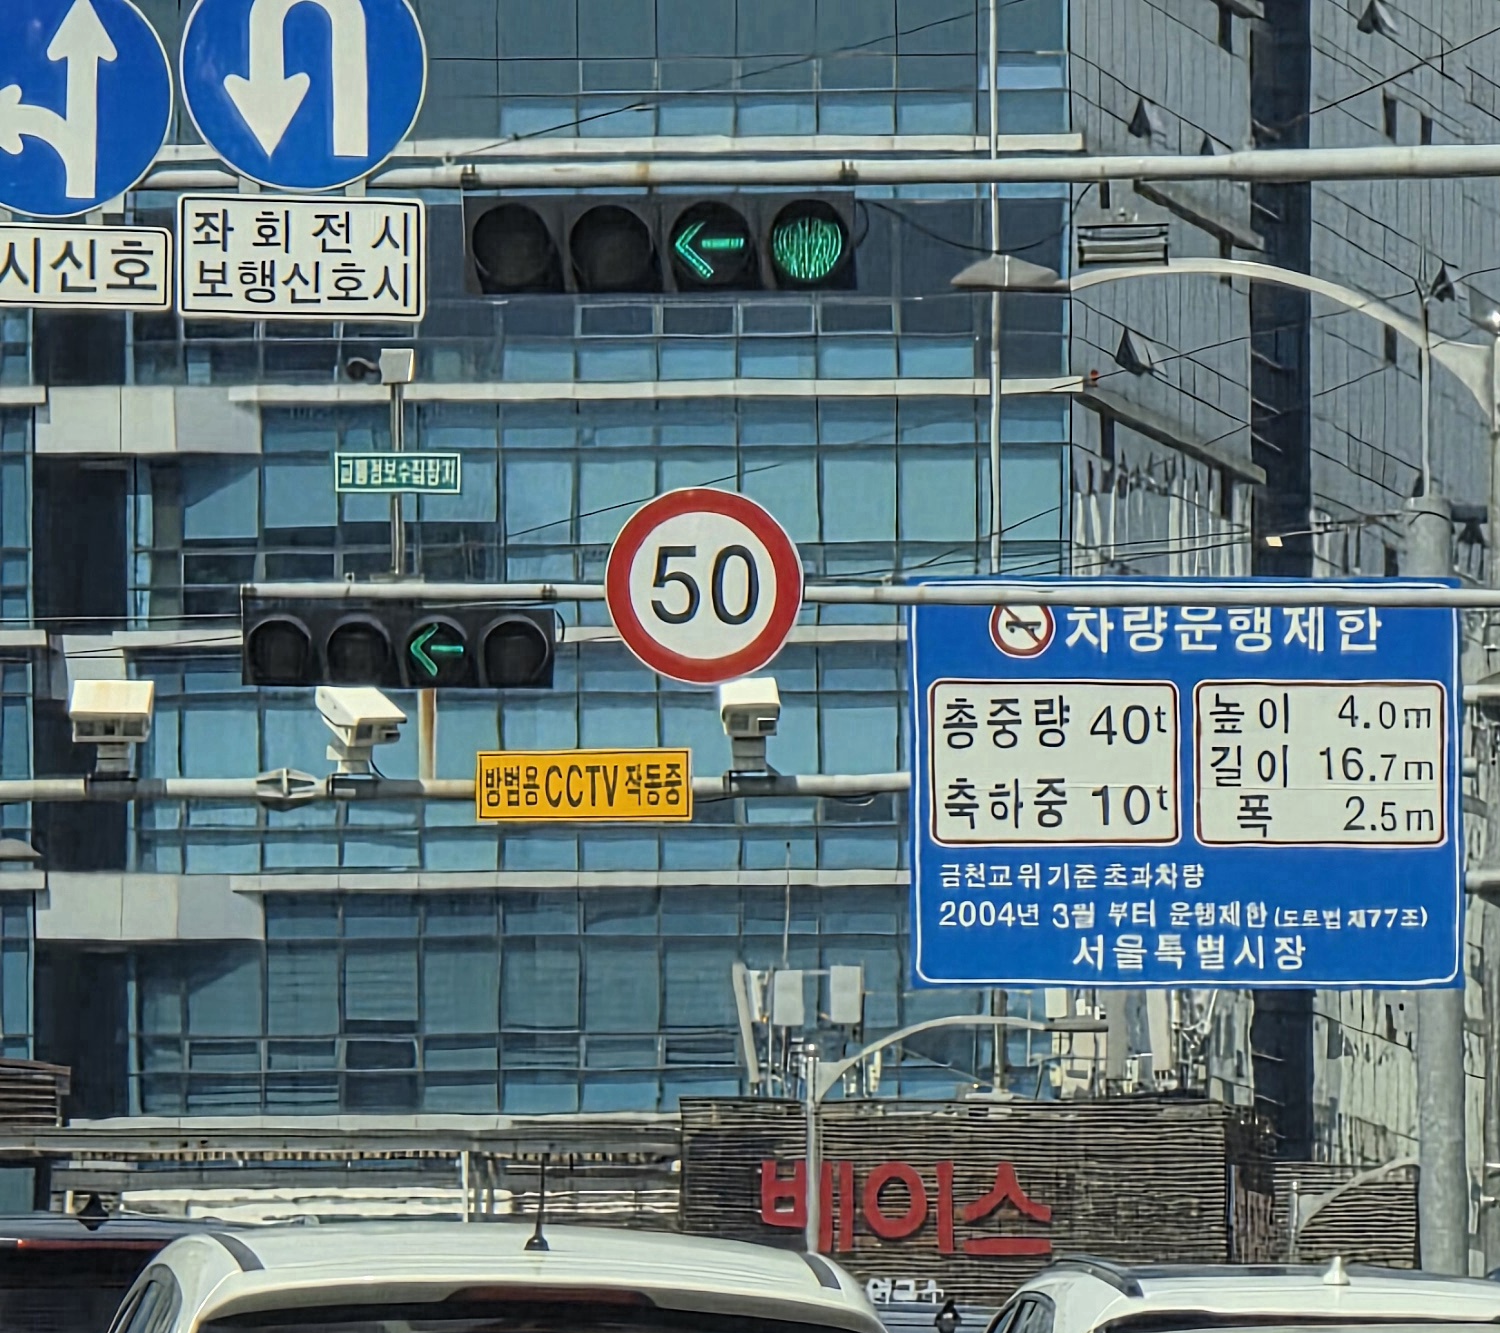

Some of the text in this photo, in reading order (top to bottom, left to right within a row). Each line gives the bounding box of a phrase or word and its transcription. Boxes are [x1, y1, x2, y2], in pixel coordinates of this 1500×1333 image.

[192, 259, 409, 307] 보행신호시
[650, 544, 760, 626] 50
[943, 694, 1071, 750] 총중량
[1209, 692, 1289, 734] 높이
[1210, 744, 1289, 788] 길이
[944, 777, 1068, 830] 축하중
[1236, 794, 1273, 838] 폭
[938, 900, 1040, 928] 2004년
[1052, 902, 1095, 929] 3월
[1108, 899, 1156, 928] 부터
[1072, 934, 1306, 971] 서울특별시장
[760, 1159, 1052, 1256] 베이스
